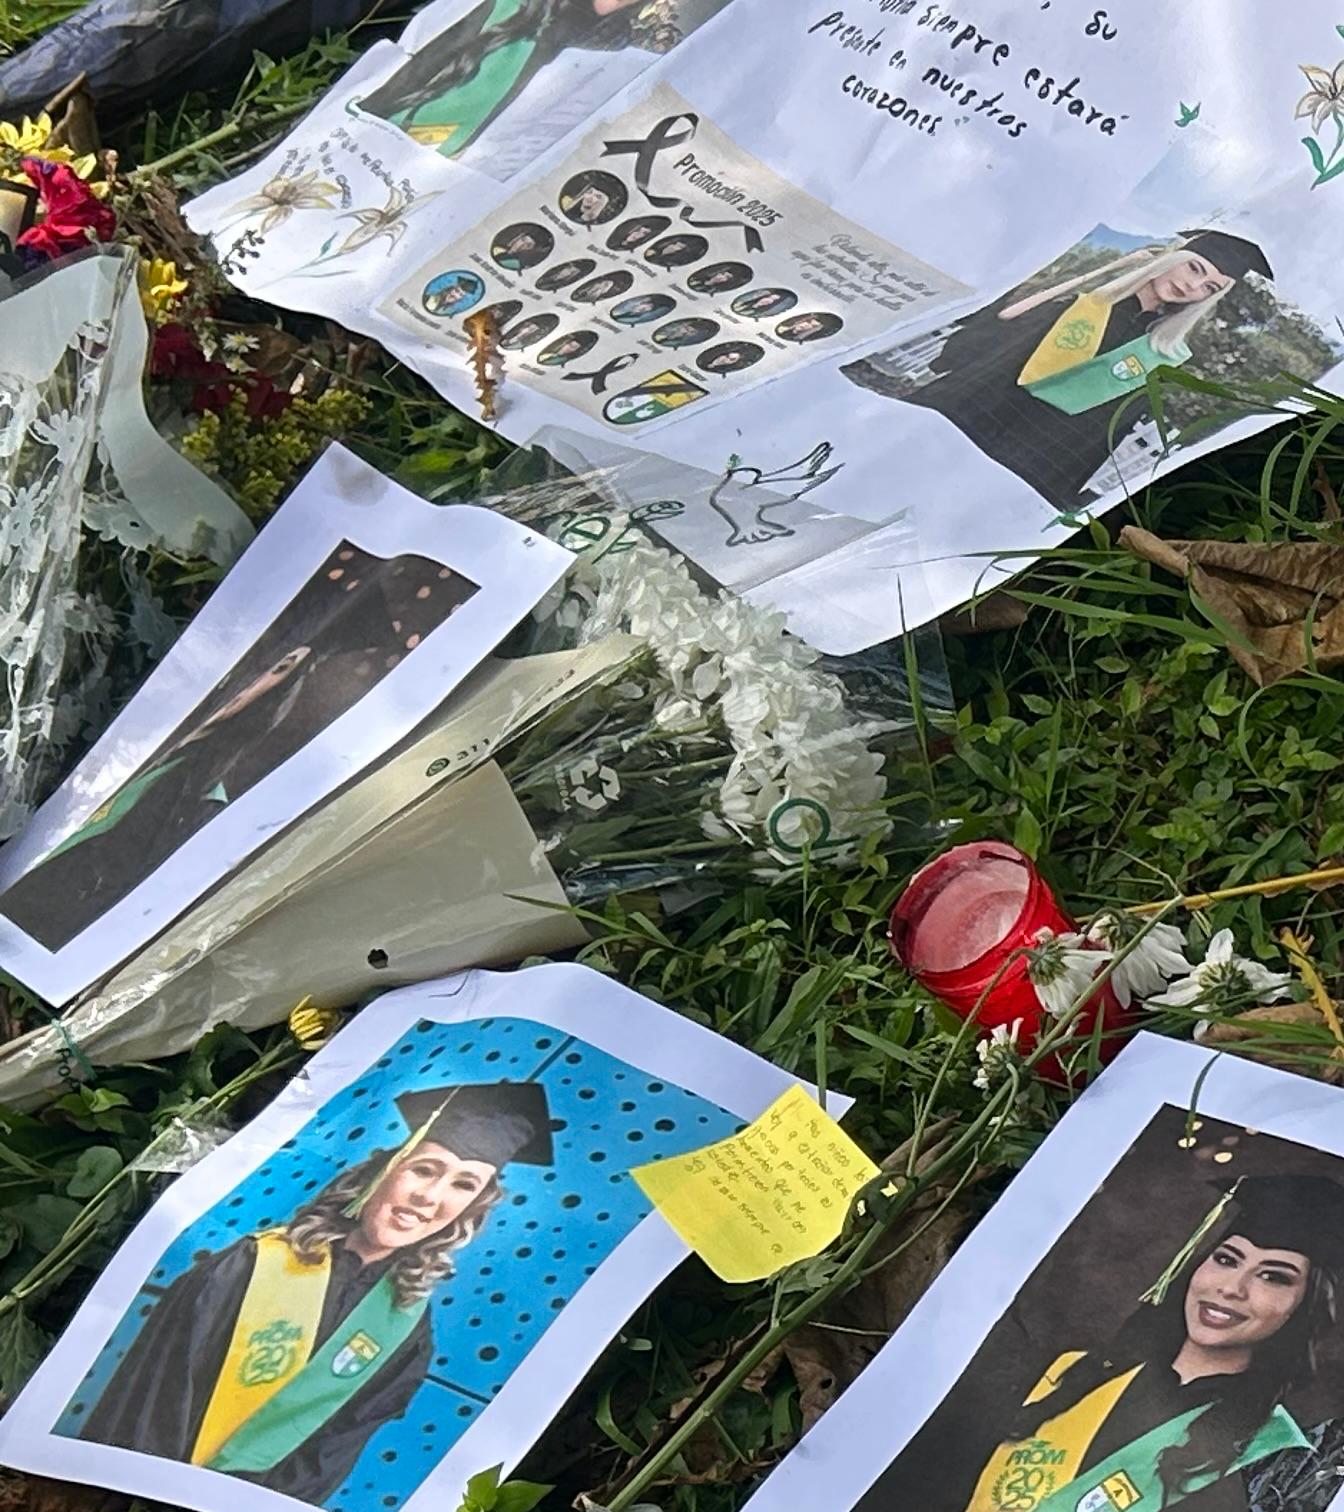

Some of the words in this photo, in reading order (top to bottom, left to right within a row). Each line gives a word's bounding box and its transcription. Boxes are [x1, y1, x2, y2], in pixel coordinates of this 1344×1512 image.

[889, 49, 907, 69] en
[922, 66, 1028, 138] nuestros
[1024, 68, 1130, 136] estará
[736, 191, 784, 229] 2025
[1006, 1448, 1067, 1467] PROM
[1006, 1467, 1044, 1490] 20
